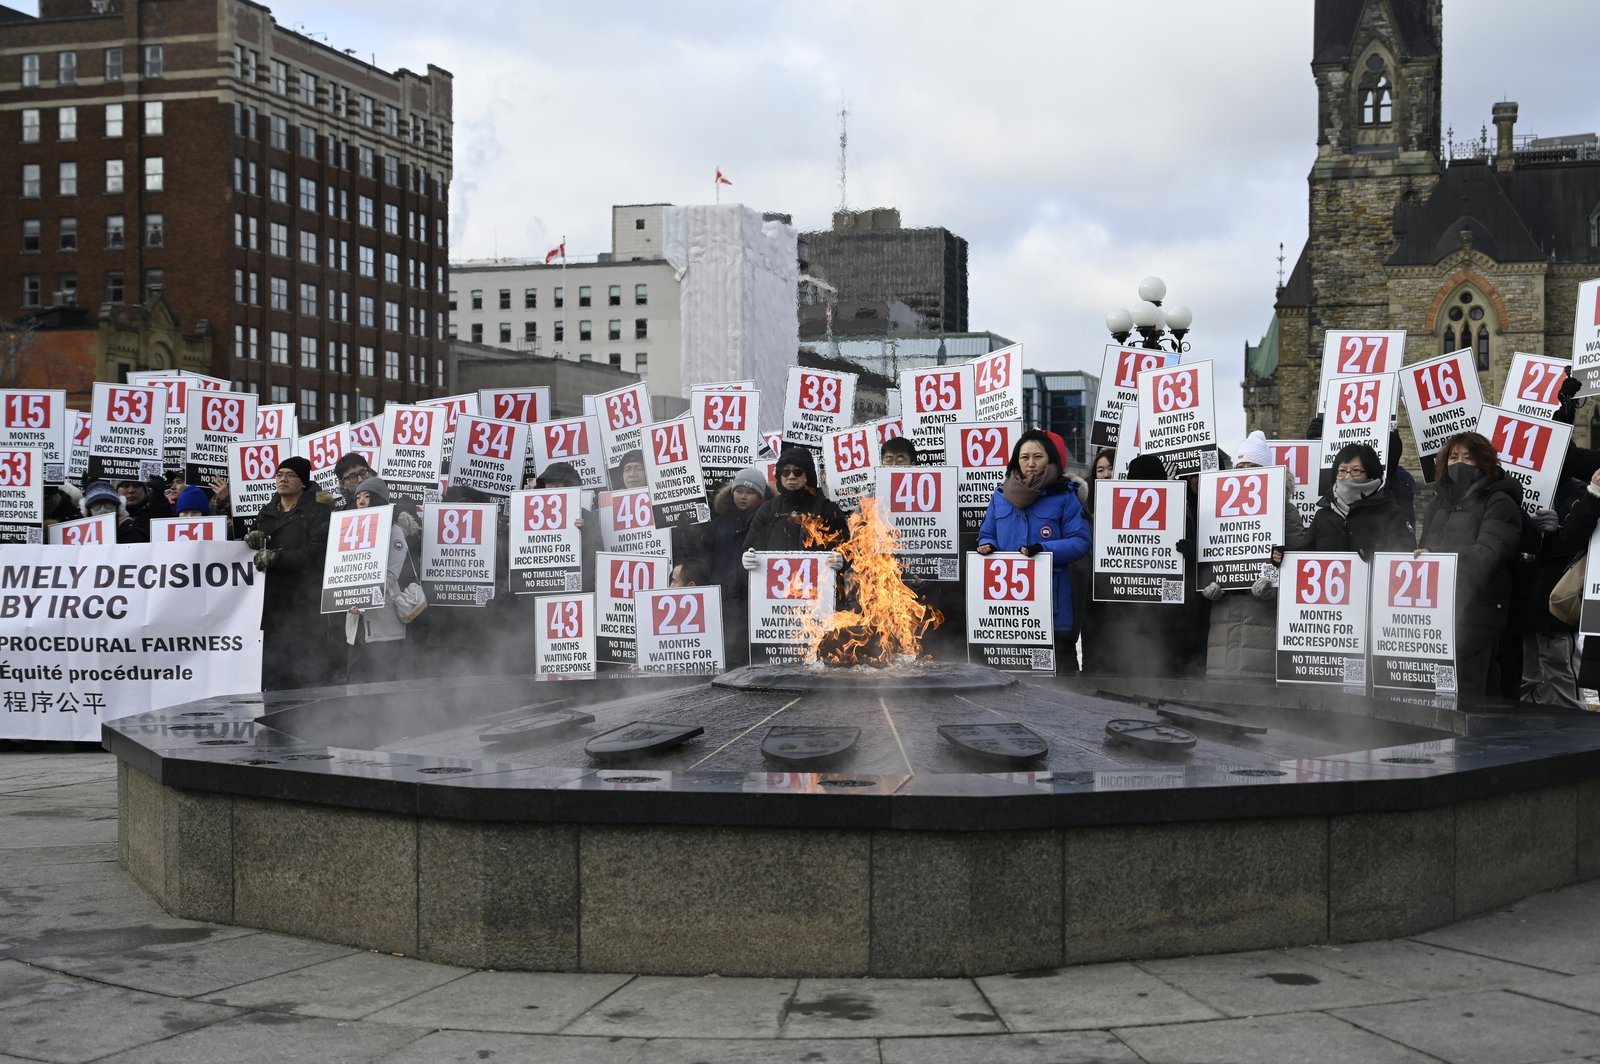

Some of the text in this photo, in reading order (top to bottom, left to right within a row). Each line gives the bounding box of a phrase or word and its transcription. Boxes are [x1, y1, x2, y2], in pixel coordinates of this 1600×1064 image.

[1342, 338, 1383, 372] 27
[979, 356, 1006, 392] 43
[1421, 363, 1458, 407] 16
[1522, 364, 1564, 402] 27
[803, 375, 837, 411] 38
[920, 374, 956, 412] 65
[979, 391, 1006, 405] MONTHS
[1158, 372, 1193, 411] 63
[112, 390, 148, 423] 53
[500, 394, 531, 423] 27
[1341, 382, 1375, 423] 35
[11, 396, 44, 427] 15
[207, 398, 239, 432] 68
[610, 392, 637, 428] 33
[708, 397, 741, 429] 34
[1429, 407, 1466, 424] MONTHS
[1518, 404, 1552, 418] MONTHS
[801, 413, 833, 423] MONTHS
[920, 414, 957, 424] MONTHS
[1158, 411, 1194, 425] MONTHS
[110, 427, 145, 436] MONTHS
[398, 412, 428, 445] 39
[1150, 421, 1205, 437] WAITING FOR
[1339, 428, 1371, 438] MONTHS
[1423, 417, 1477, 439] WAITING FOR
[100, 435, 154, 446] WAITING FOR
[473, 422, 508, 458] 34
[550, 424, 582, 457] 27
[615, 431, 640, 441] MONTHS
[707, 435, 740, 443] MONTHS
[1145, 432, 1210, 450] IRCC RESPONSE
[94, 444, 158, 456] IRCC RESPONSE
[314, 432, 338, 469] 55
[656, 426, 683, 463] 24
[838, 431, 866, 470] 55
[966, 428, 1004, 466] 62
[1498, 420, 1539, 469] 11
[396, 449, 425, 458] MONTHS
[244, 446, 276, 479] 68
[387, 459, 416, 468] WAITING
[470, 459, 504, 471] MONTHS
[399, 470, 435, 479] RESPONSE
[460, 468, 512, 482] WAITING FOR
[660, 466, 687, 477] MONTHS
[967, 472, 1003, 480] MONTHS
[454, 477, 515, 491] IRCC RESPONSE
[655, 476, 695, 489] WAITING FOR
[654, 485, 701, 501] IRCC RESPONSE
[896, 473, 936, 511] 40
[1221, 476, 1262, 516] 23
[528, 495, 562, 530] 33
[617, 493, 649, 528] 46
[1119, 489, 1159, 528] 72
[443, 510, 476, 543] 81
[896, 517, 936, 526] MONTHS
[1220, 521, 1260, 531] MONTHS
[344, 515, 370, 550] 41
[528, 534, 562, 543] MONTHS
[618, 530, 652, 542] MONTHS
[928, 529, 946, 537] FOR
[1118, 535, 1160, 544] MONTHS
[1209, 532, 1271, 544] WAITING FOR
[520, 545, 554, 554] WAITING
[646, 540, 661, 548] FOR
[1107, 546, 1171, 556] WAITING FOR
[342, 552, 371, 562] MONTHS
[441, 549, 476, 557] MONTHS
[1203, 547, 1224, 557] IRCC
[432, 558, 484, 567] WAITING FOR
[514, 554, 575, 565] IRCC RESPONSE
[1100, 558, 1177, 569] IRCC RESPONSE
[333, 561, 378, 574] WAITING FOR
[426, 569, 489, 578] IRCC RESPONSE
[2, 562, 254, 589] MELY DECISION
[328, 571, 381, 584] IRCC RESPONSE
[615, 562, 649, 597] 40
[772, 558, 812, 599] 34
[989, 560, 1030, 600] 35
[1302, 560, 1345, 604] 36
[1126, 587, 1162, 595] RESULTS
[1394, 562, 1431, 606] 21
[343, 588, 373, 597] TIMELINES
[0, 595, 128, 619] BY IRCC
[344, 596, 370, 604] RESULTS
[658, 595, 699, 634] 22
[989, 606, 1029, 615] MONTHS
[1300, 610, 1342, 621] MONTHS
[550, 602, 578, 637] 43
[979, 618, 1040, 628] WAITING FOR
[1392, 614, 1431, 625] MONTHS
[756, 630, 777, 639] IRCC
[974, 631, 1046, 640] IRCC RESPONSE
[1289, 623, 1353, 634] WAITING FOR
[1382, 627, 1442, 640] WAITING FOR
[0, 636, 242, 652] PROCEDURAL FAIRNESS
[551, 642, 579, 651] MONTHS
[659, 639, 700, 649] MONTHS
[1283, 636, 1359, 648] IRCC RESPONSE
[1377, 640, 1448, 654] IRCC RESPONSE
[649, 650, 712, 662] WAITING FOR
[0, 661, 192, 683] Équité procédurale
[541, 663, 591, 673] IRCC RESPONSE
[1309, 667, 1344, 676] RESULTS
[1391, 672, 1436, 683] NO RESULTS
[4, 691, 106, 714] 程序公平
